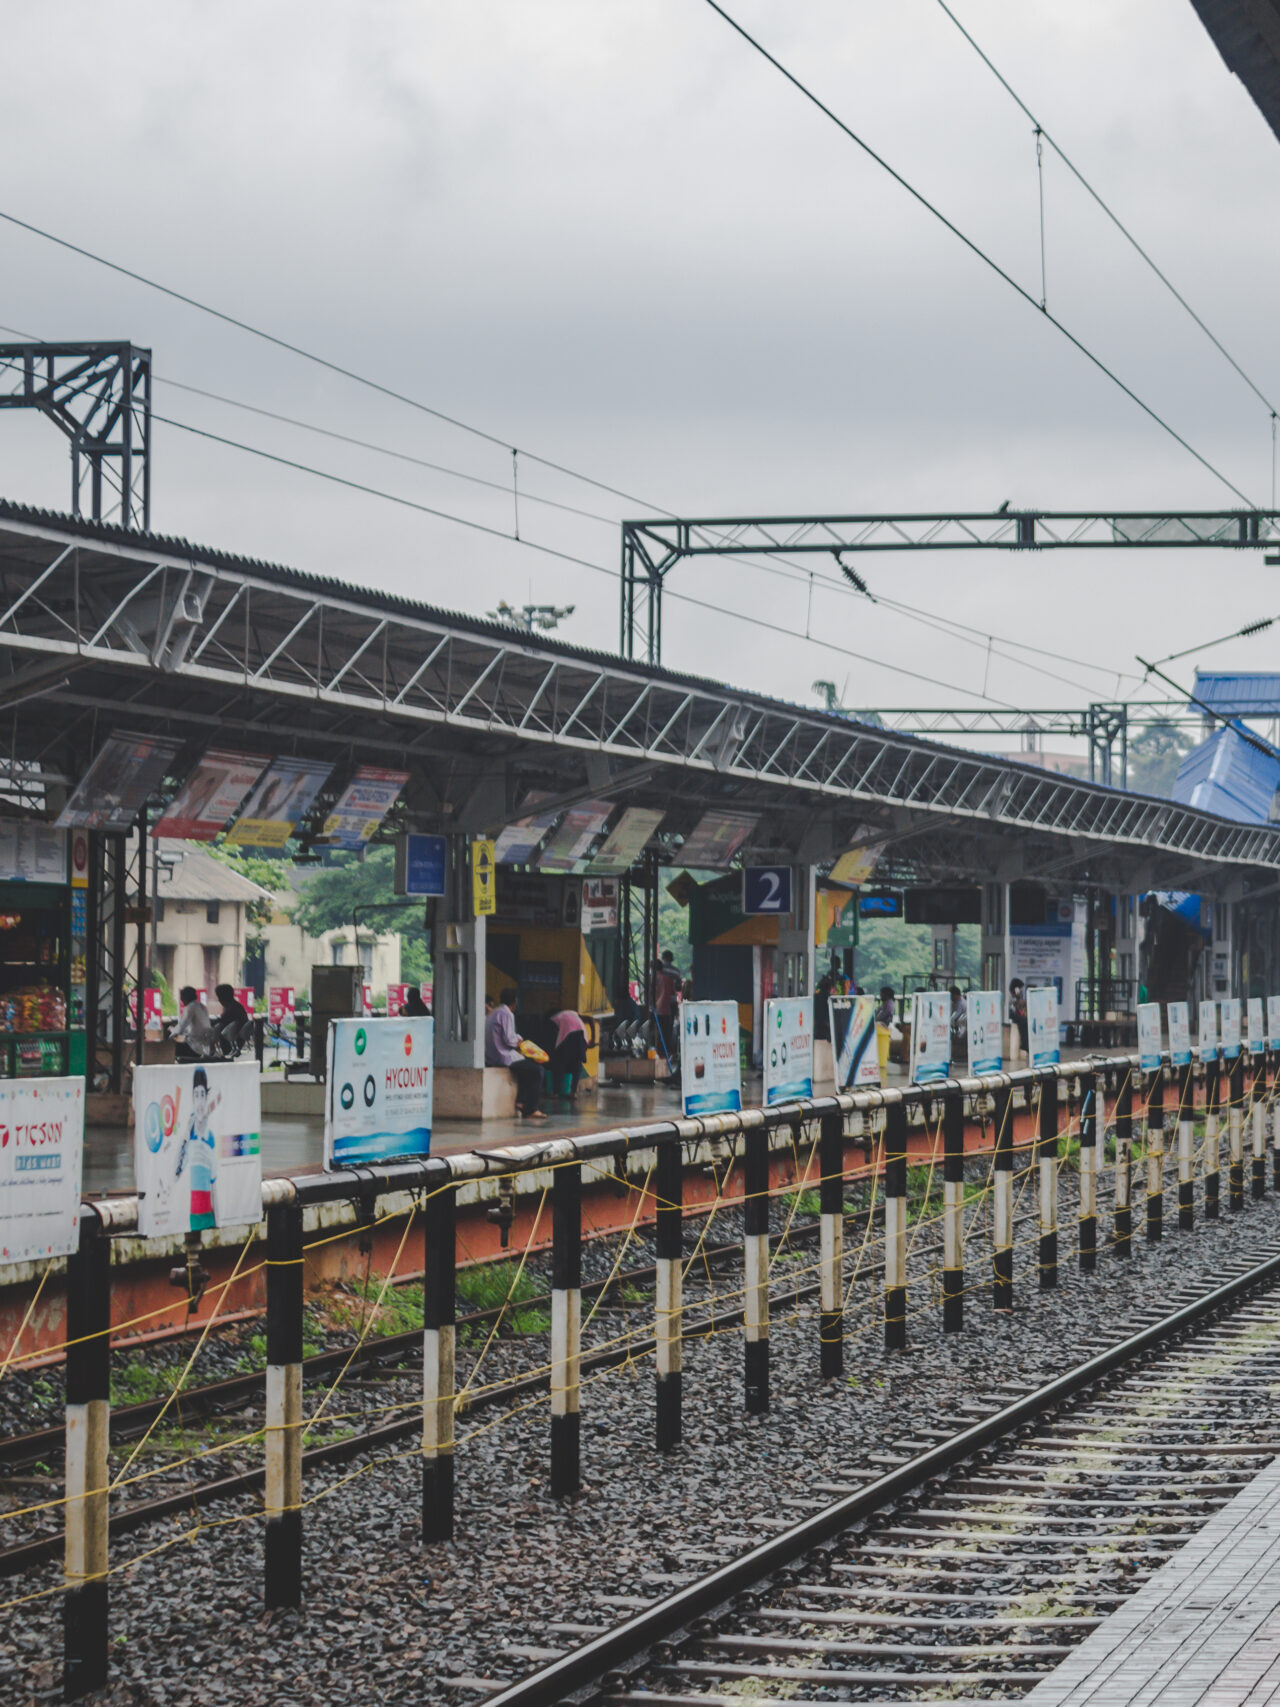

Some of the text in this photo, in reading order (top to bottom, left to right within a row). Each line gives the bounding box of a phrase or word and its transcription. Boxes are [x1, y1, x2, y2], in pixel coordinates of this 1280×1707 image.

[758, 871, 782, 909] 2
[385, 1066, 429, 1089] HYCOUNT
[15, 1121, 63, 1147] TICSON
